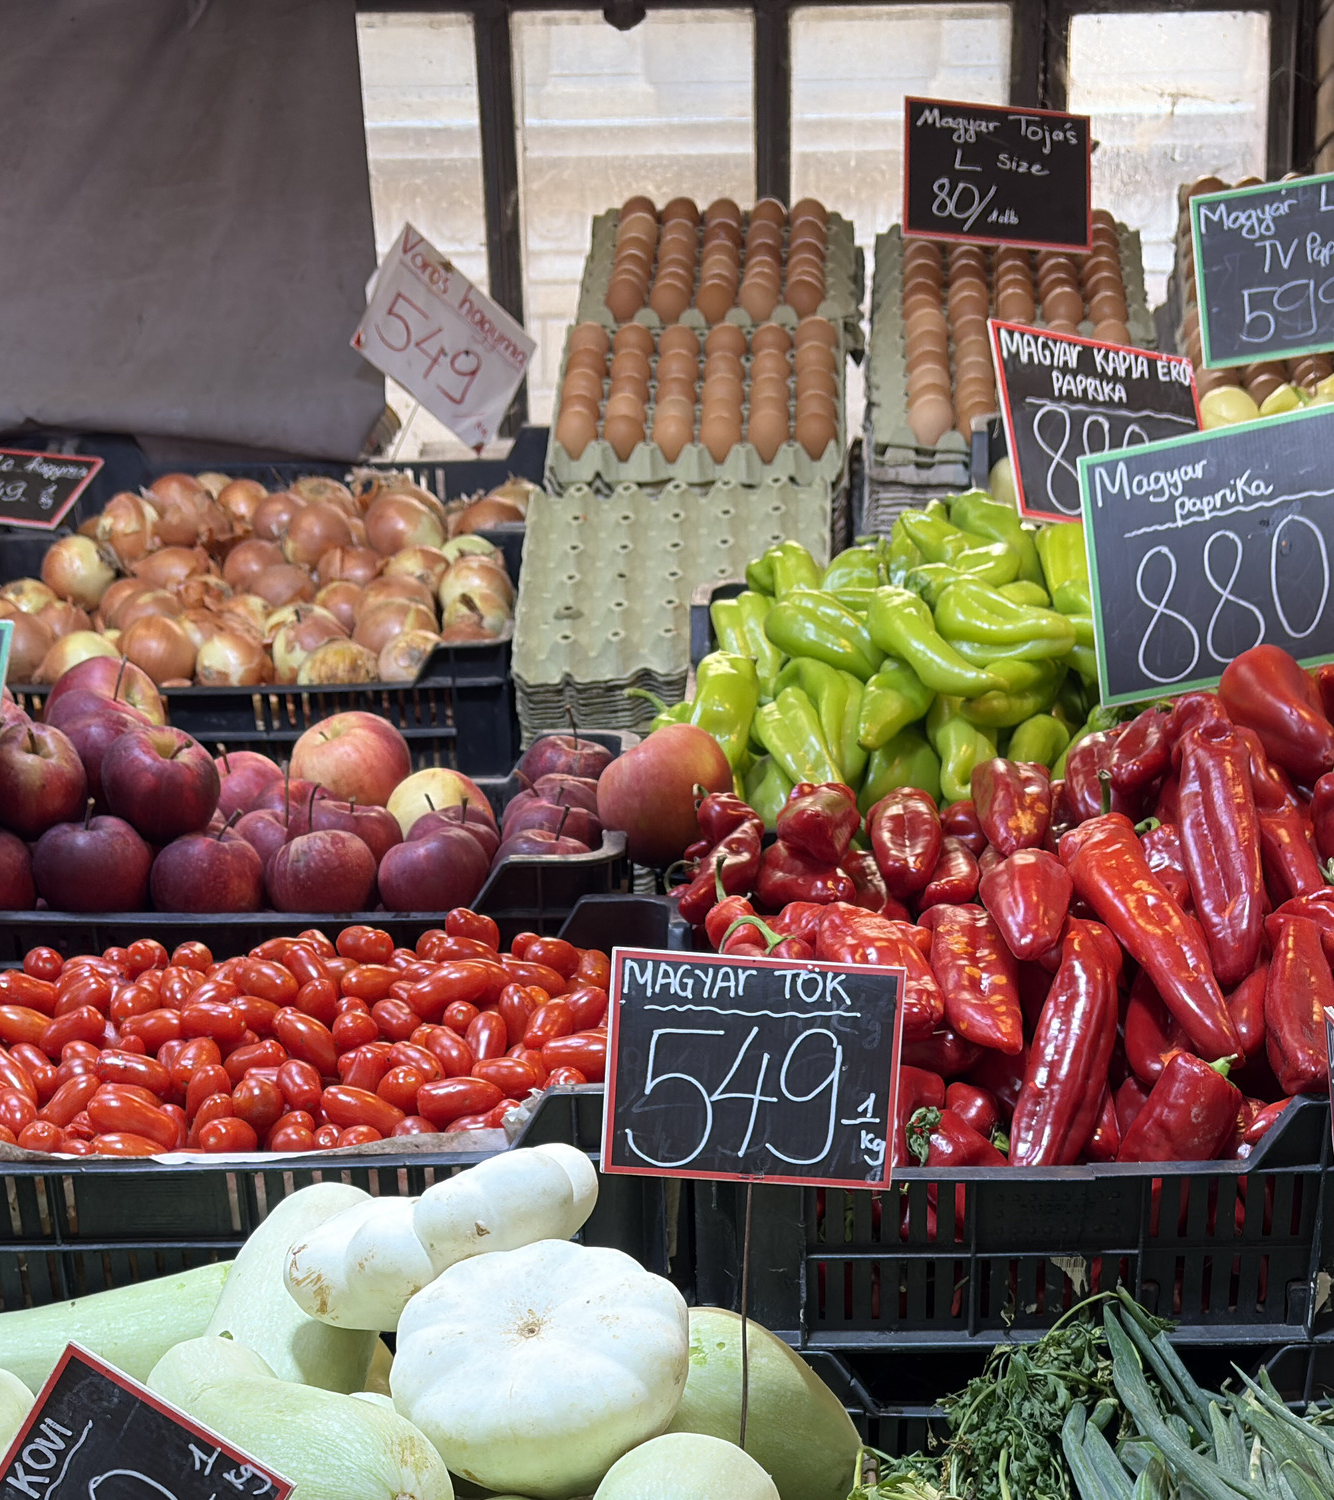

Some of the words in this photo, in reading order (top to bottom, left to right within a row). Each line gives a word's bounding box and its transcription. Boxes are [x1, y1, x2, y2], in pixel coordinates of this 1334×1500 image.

[916, 108, 1001, 144] Magyar
[1008, 115, 1078, 154] Tojás
[954, 148, 982, 172] L
[1199, 196, 1297, 239] Magyar
[1254, 238, 1299, 273] TV
[374, 291, 482, 405] 549
[1093, 347, 1149, 380] KAPIA
[1051, 370, 1127, 404] PAPRIKA
[1094, 459, 1207, 508] Magyar
[1136, 514, 1330, 683] 880
[774, 964, 851, 1005] TÖK
[625, 1026, 843, 1168] 549
[5, 1416, 74, 1499] KOVI
